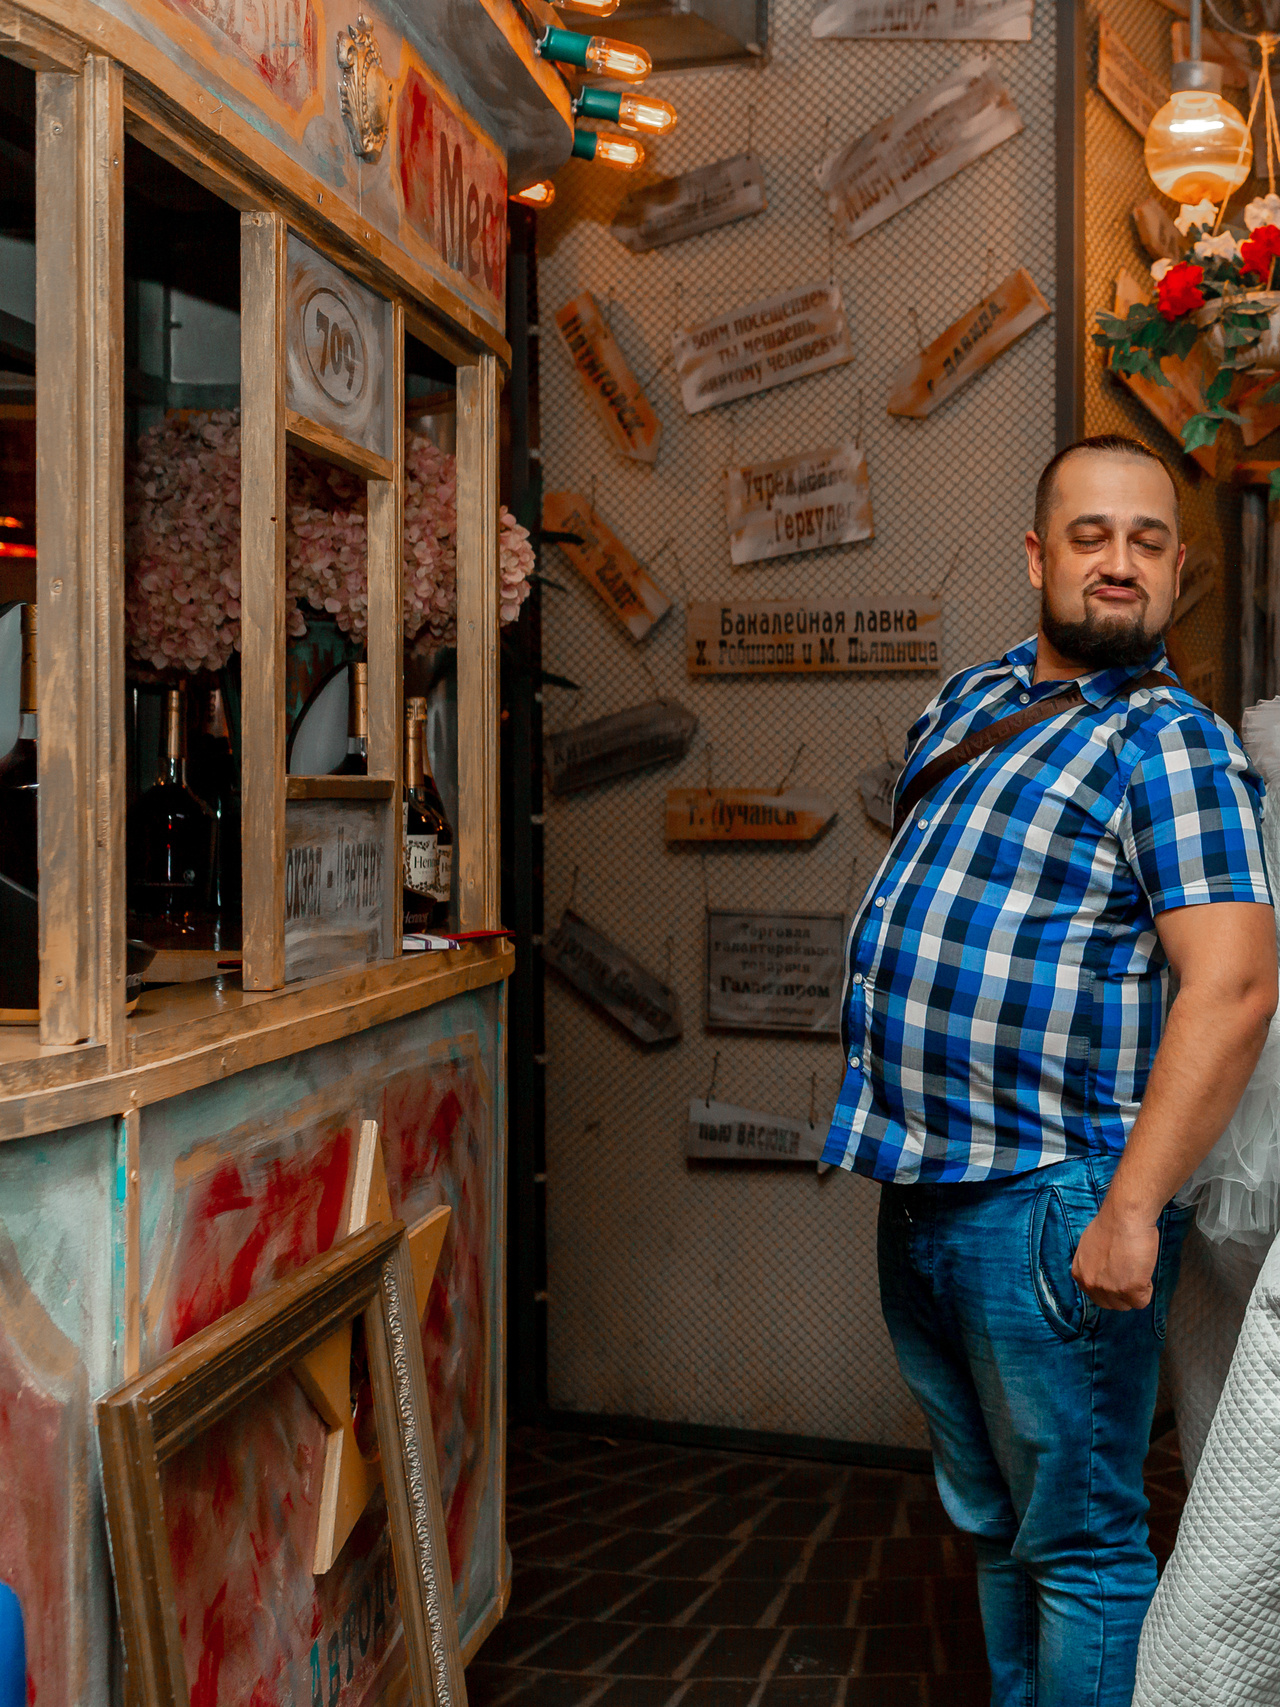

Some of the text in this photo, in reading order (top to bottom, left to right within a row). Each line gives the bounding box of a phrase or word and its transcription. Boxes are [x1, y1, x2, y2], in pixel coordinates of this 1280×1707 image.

[316, 308, 355, 390] 709
[720, 608, 918, 636] Бакалейная лавка
[695, 639, 712, 666] Х.
[718, 638, 795, 666] Робинзон
[801, 642, 813, 664] и
[819, 637, 840, 664] М.
